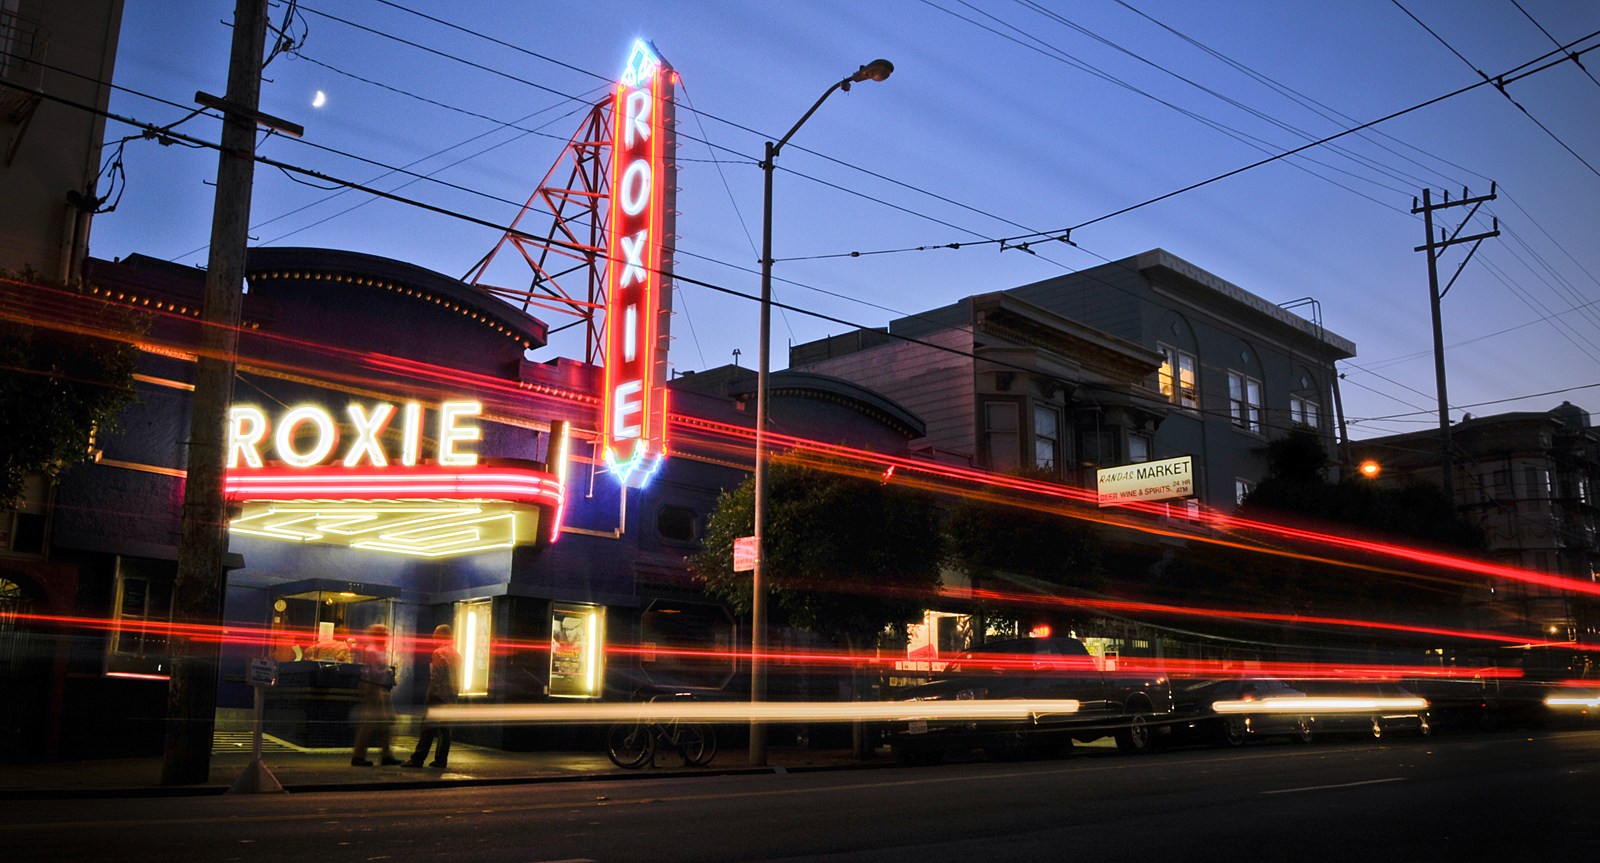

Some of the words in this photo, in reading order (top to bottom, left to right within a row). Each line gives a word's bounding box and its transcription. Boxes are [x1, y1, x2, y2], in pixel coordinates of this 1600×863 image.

[613, 87, 652, 442] ROXIE
[226, 401, 483, 468] ROXIE
[1099, 471, 1134, 484] RANDAS
[1136, 461, 1190, 480] MARKET
[1100, 493, 1118, 501] BEER
[1120, 490, 1137, 498] WINE
[1138, 488, 1143, 496] &
